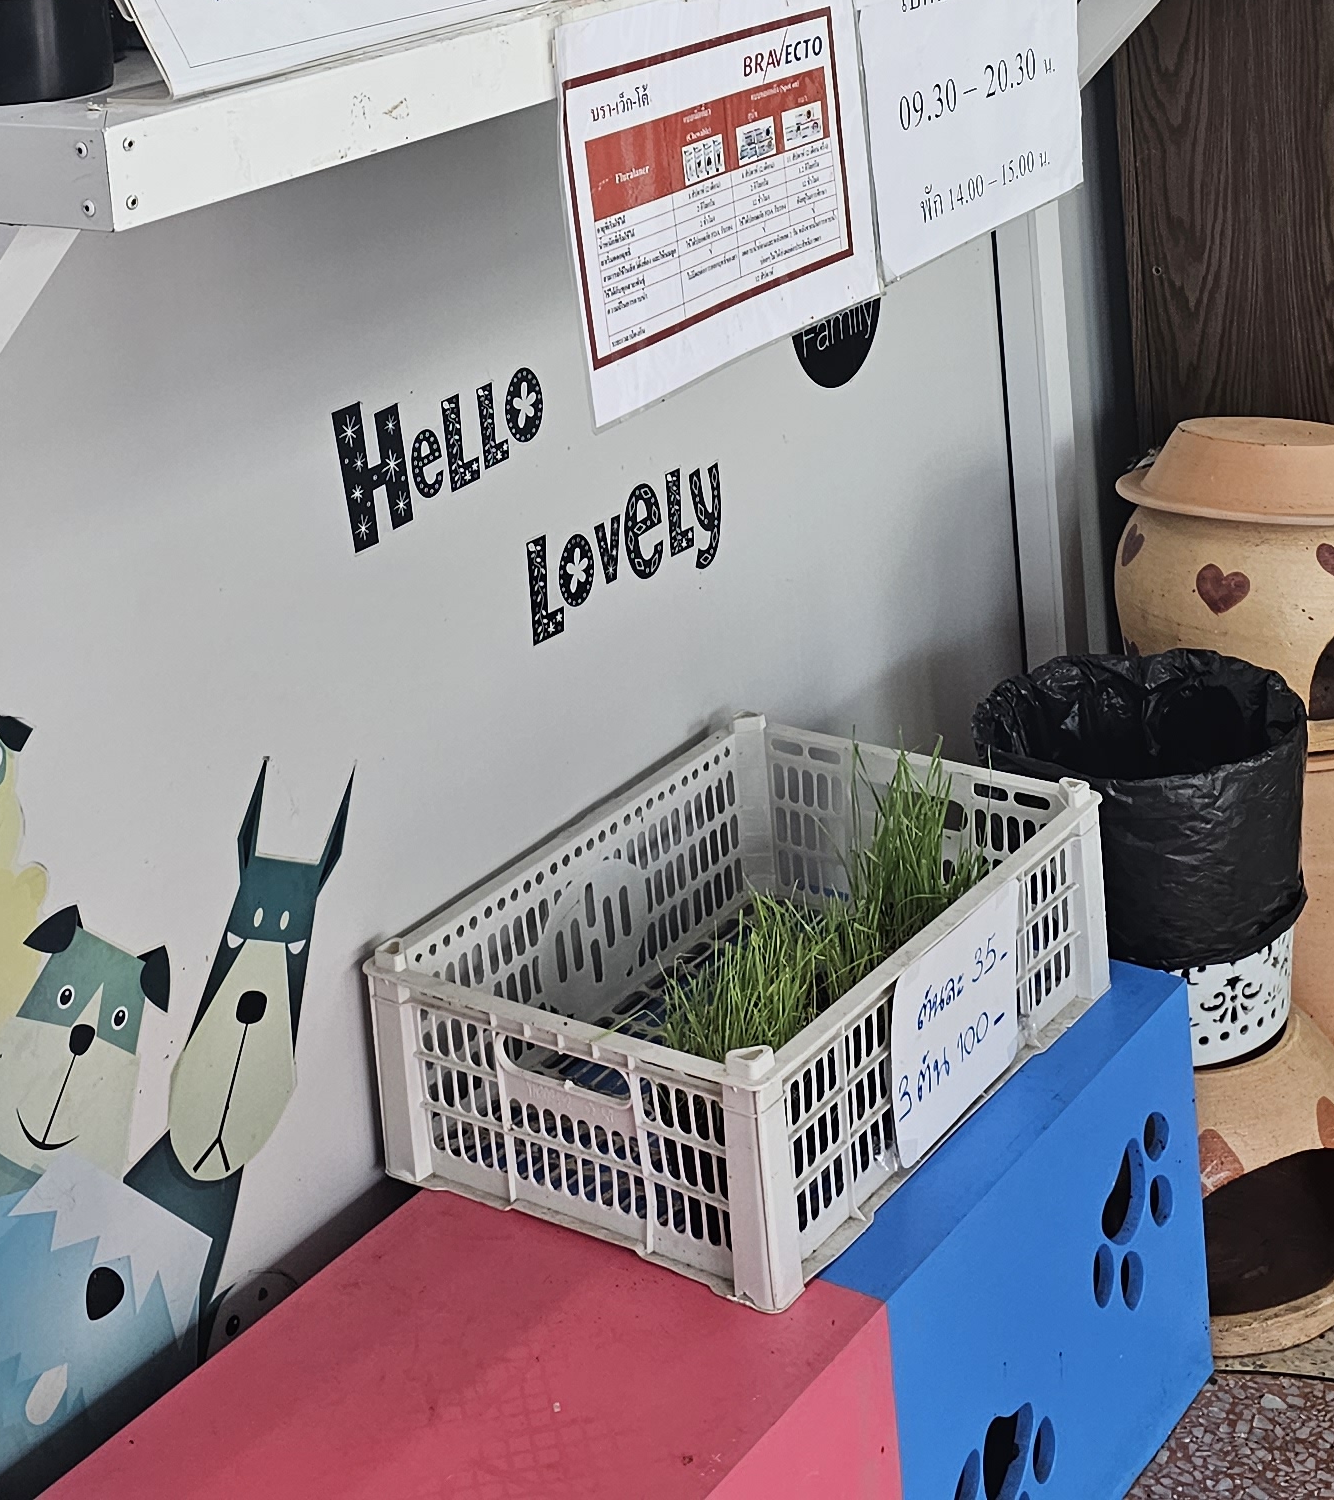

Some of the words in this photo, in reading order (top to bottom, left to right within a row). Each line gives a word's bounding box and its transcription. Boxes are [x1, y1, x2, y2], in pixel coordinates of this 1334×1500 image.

[743, 30, 824, 80] BRAVECTO
[590, 84, 651, 123] บรา-เว็ก-โต้
[898, 77, 958, 132] 09.30
[983, 47, 1037, 102] 20.30
[1042, 55, 1057, 75] น.
[615, 164, 651, 184] Fluralaner
[919, 184, 945, 225] พัก
[947, 180, 985, 219] 14.00
[1000, 149, 1036, 191] 15.00
[1038, 147, 1051, 168] น.
[917, 973, 965, 1031] ต้นละ
[898, 1074, 913, 1123] 3
[917, 1047, 950, 1103] ต้น
